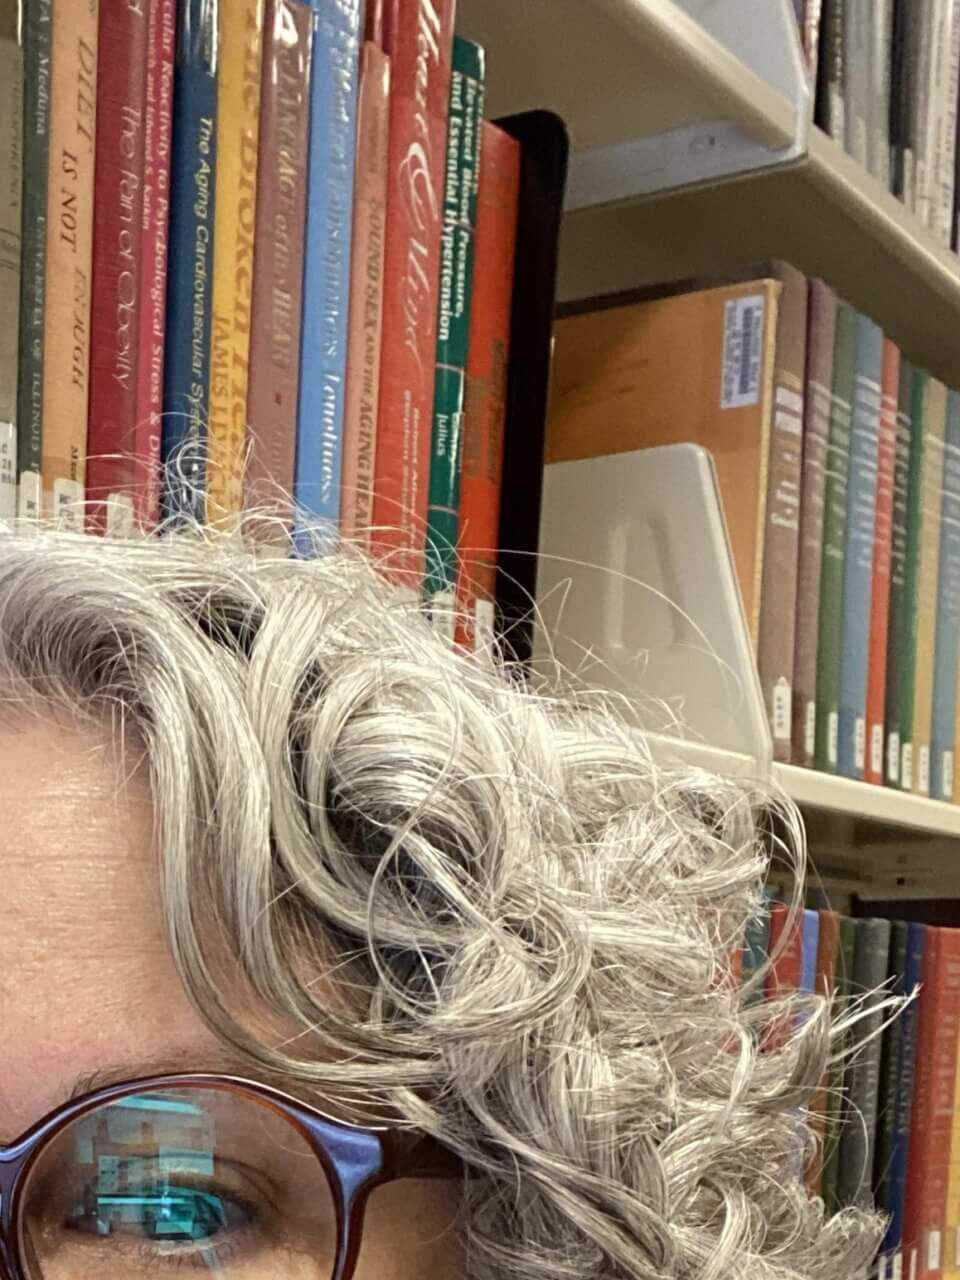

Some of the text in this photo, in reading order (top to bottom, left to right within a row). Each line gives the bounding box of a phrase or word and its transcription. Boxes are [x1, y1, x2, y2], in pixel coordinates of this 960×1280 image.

[76, 35, 96, 150] DIET
[198, 117, 212, 154] The
[59, 151, 79, 253] IS NOT
[150, 60, 173, 404] Reactivity to Psychological Stress
[194, 160, 211, 219] Aging
[438, 71, 463, 340] and Essential Hypertension
[455, 77, 477, 318] Elevated Blood Pressure,
[111, 106, 141, 391] The Pain of Obesity
[191, 225, 209, 377] Cardiovascular
[364, 284, 380, 333] SEX
[357, 400, 374, 471] AGING
[436, 413, 449, 456] Julius
